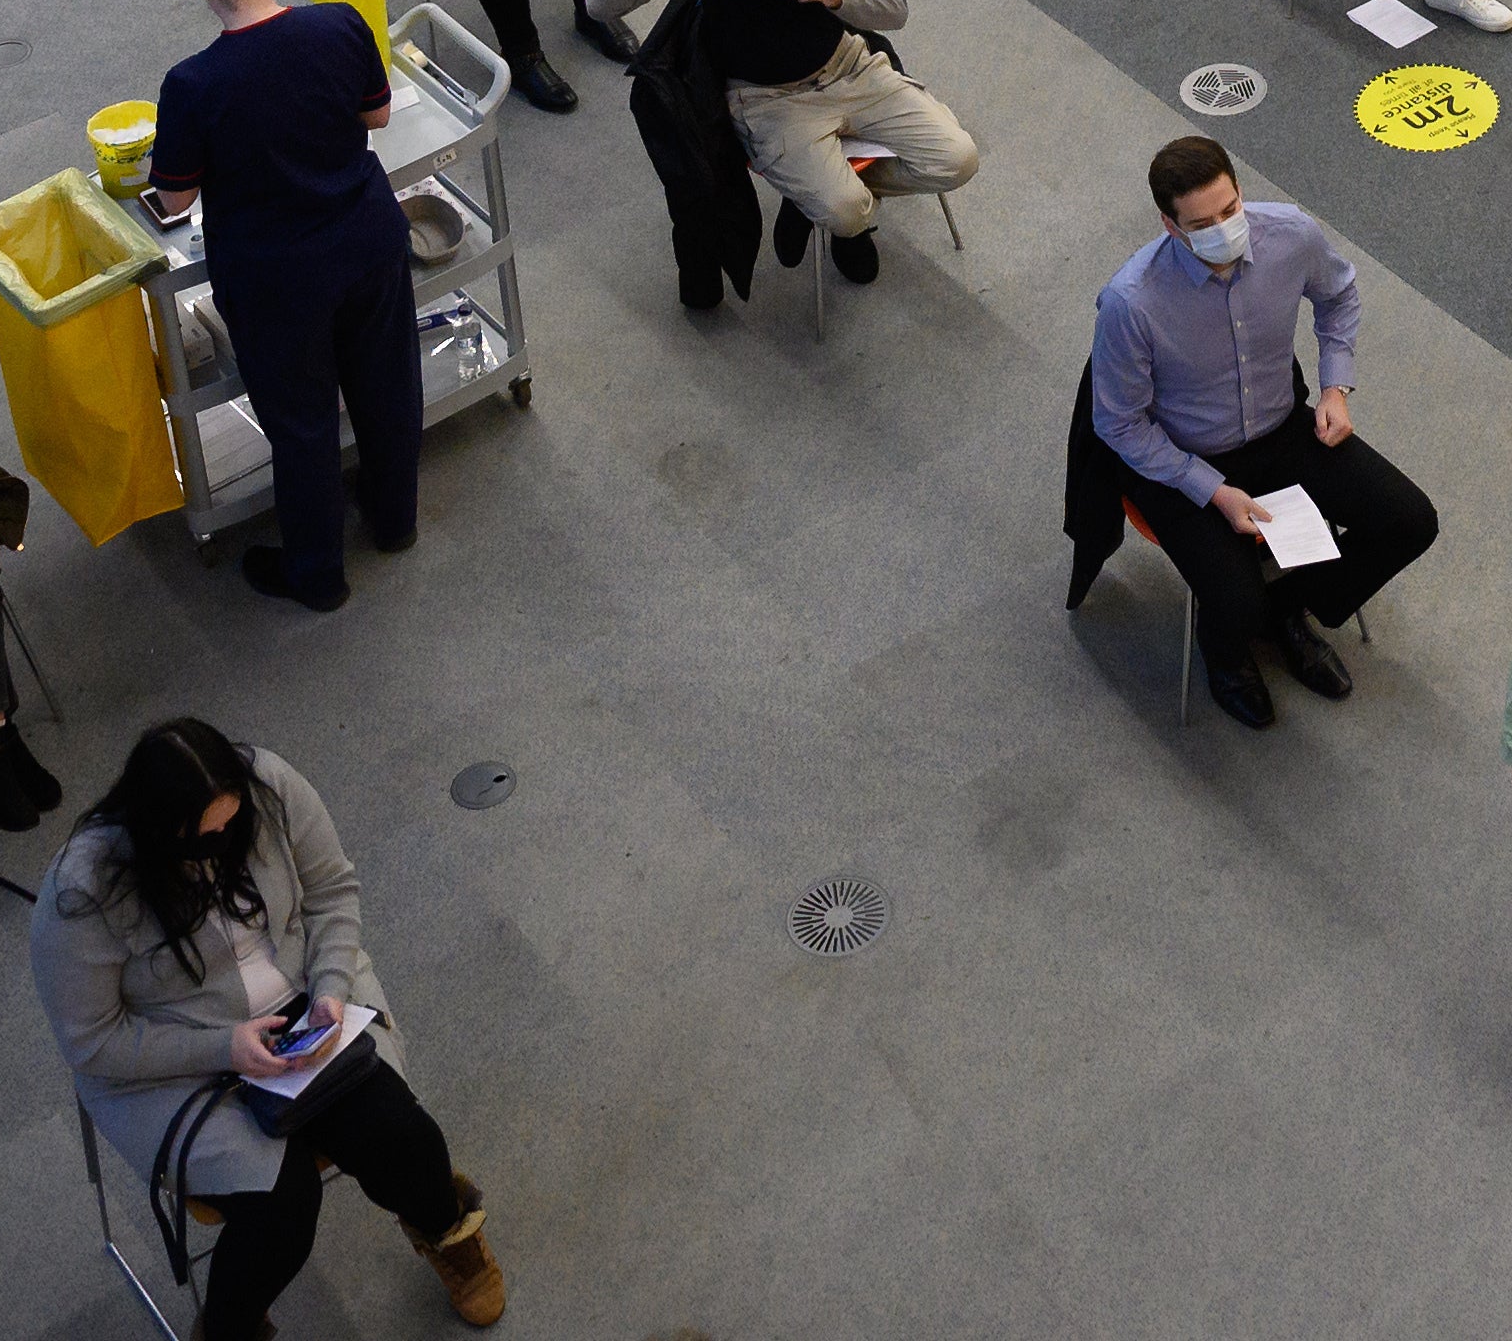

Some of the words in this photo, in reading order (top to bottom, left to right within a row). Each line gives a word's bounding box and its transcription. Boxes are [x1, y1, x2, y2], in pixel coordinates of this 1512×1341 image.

[1379, 91, 1408, 108] times
[1381, 81, 1453, 119] distance
[1408, 83, 1422, 95] all
[1402, 94, 1471, 130] 2m
